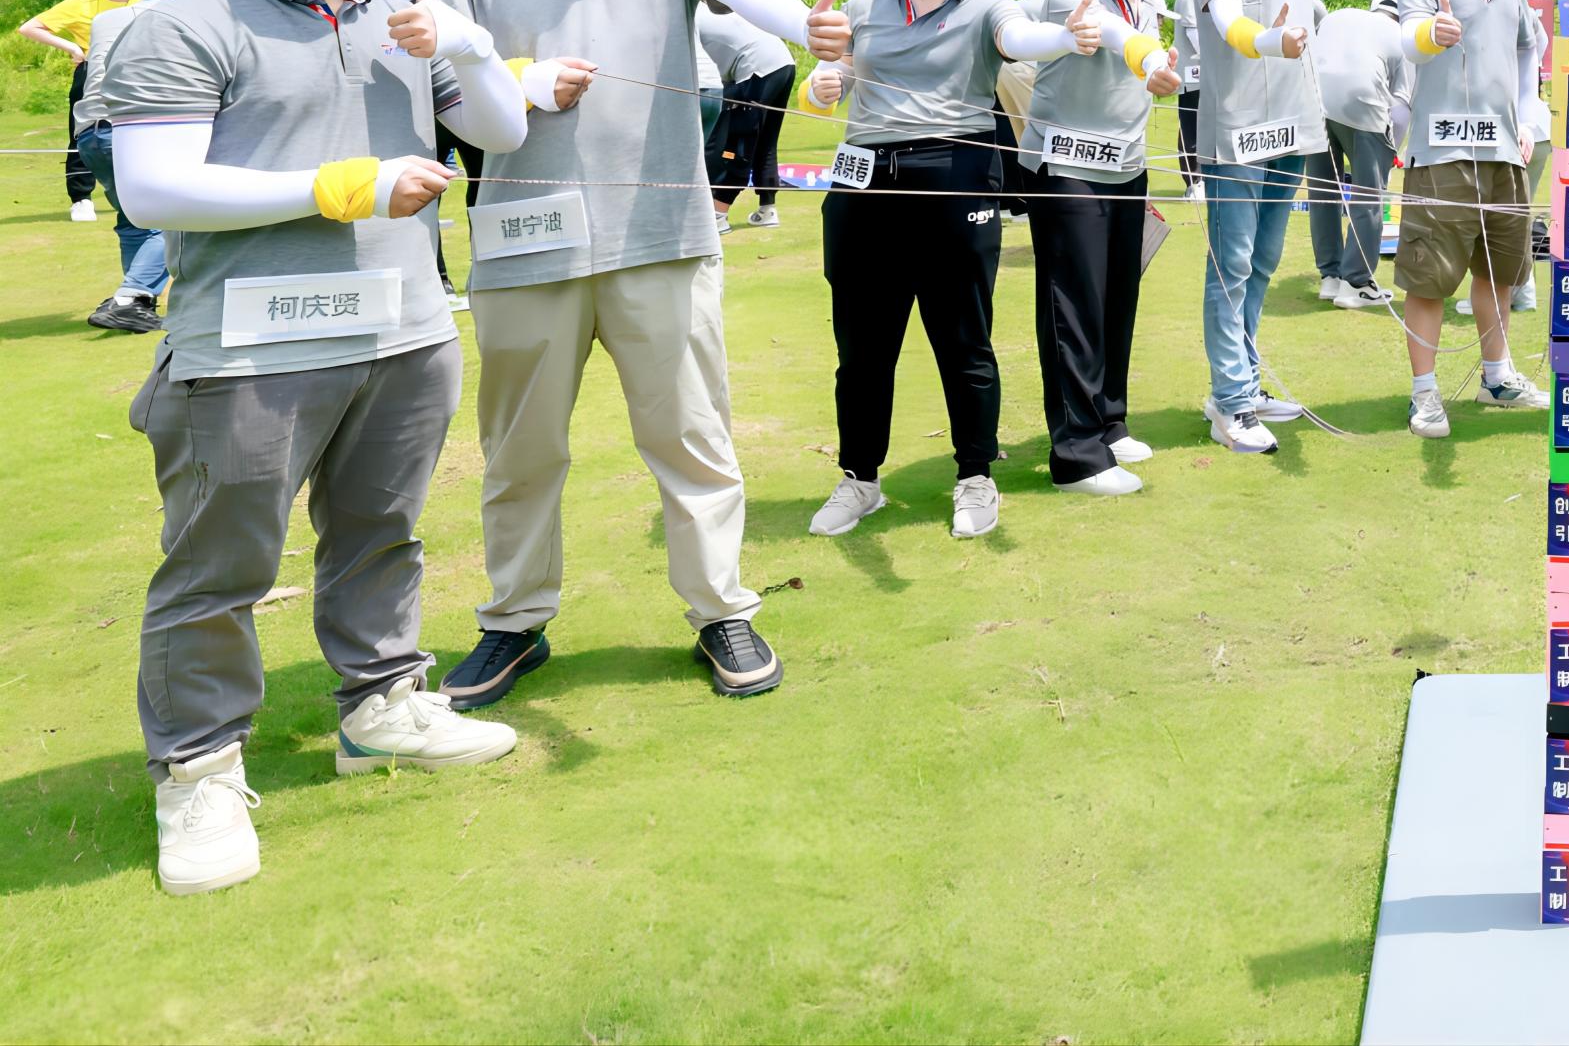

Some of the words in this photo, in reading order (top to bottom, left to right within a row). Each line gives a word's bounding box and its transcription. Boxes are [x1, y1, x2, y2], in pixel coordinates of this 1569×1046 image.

[1434, 120, 1497, 142] 李小胜
[268, 292, 360, 322] 柯庆贤
